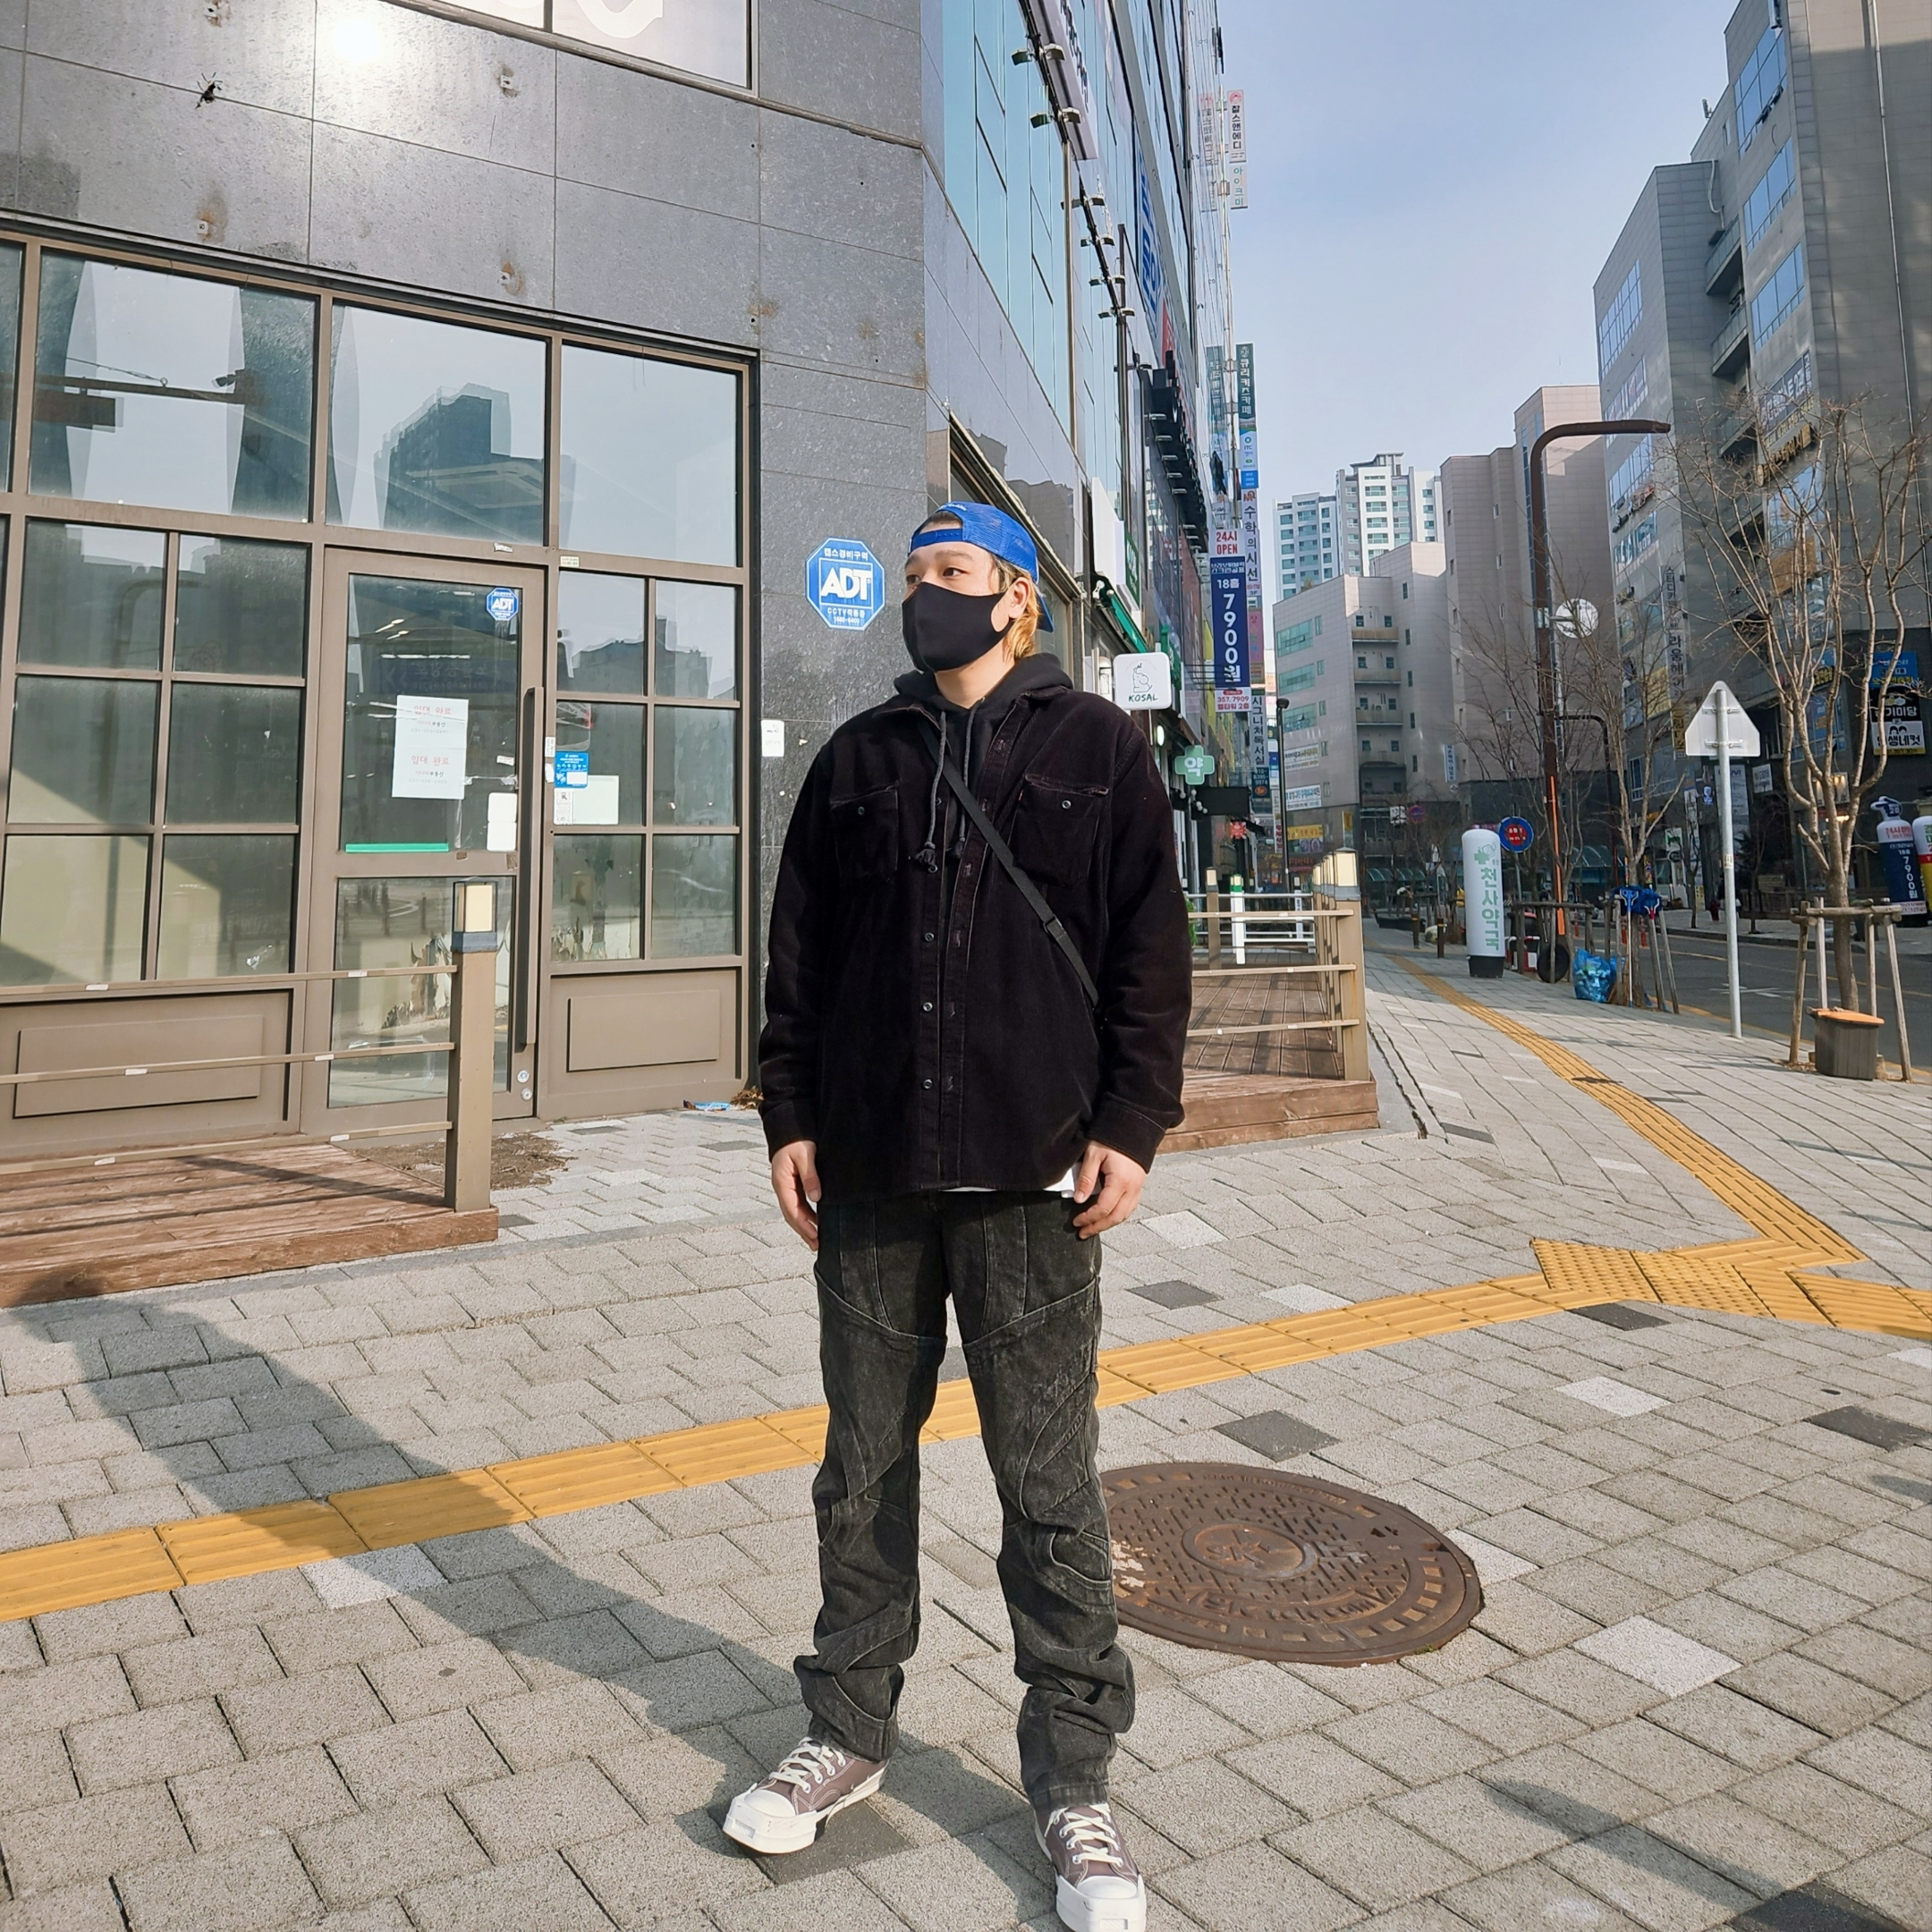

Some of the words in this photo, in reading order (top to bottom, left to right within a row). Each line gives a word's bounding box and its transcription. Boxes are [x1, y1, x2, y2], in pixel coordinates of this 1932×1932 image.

[1216, 530, 1238, 542] 24시
[1244, 505, 1258, 581] 수학의시선
[1217, 544, 1238, 555] OPEN
[820, 566, 872, 600] ADT
[492, 597, 514, 611] ADT
[1128, 693, 1159, 703] KOSAL
[1875, 706, 1918, 717] 기미당
[1252, 696, 1266, 766] 시그니처독서실
[411, 755, 428, 765] 임대
[433, 757, 450, 767] 완료
[1184, 757, 1204, 777] 약
[1480, 867, 1501, 951] 천사약국
